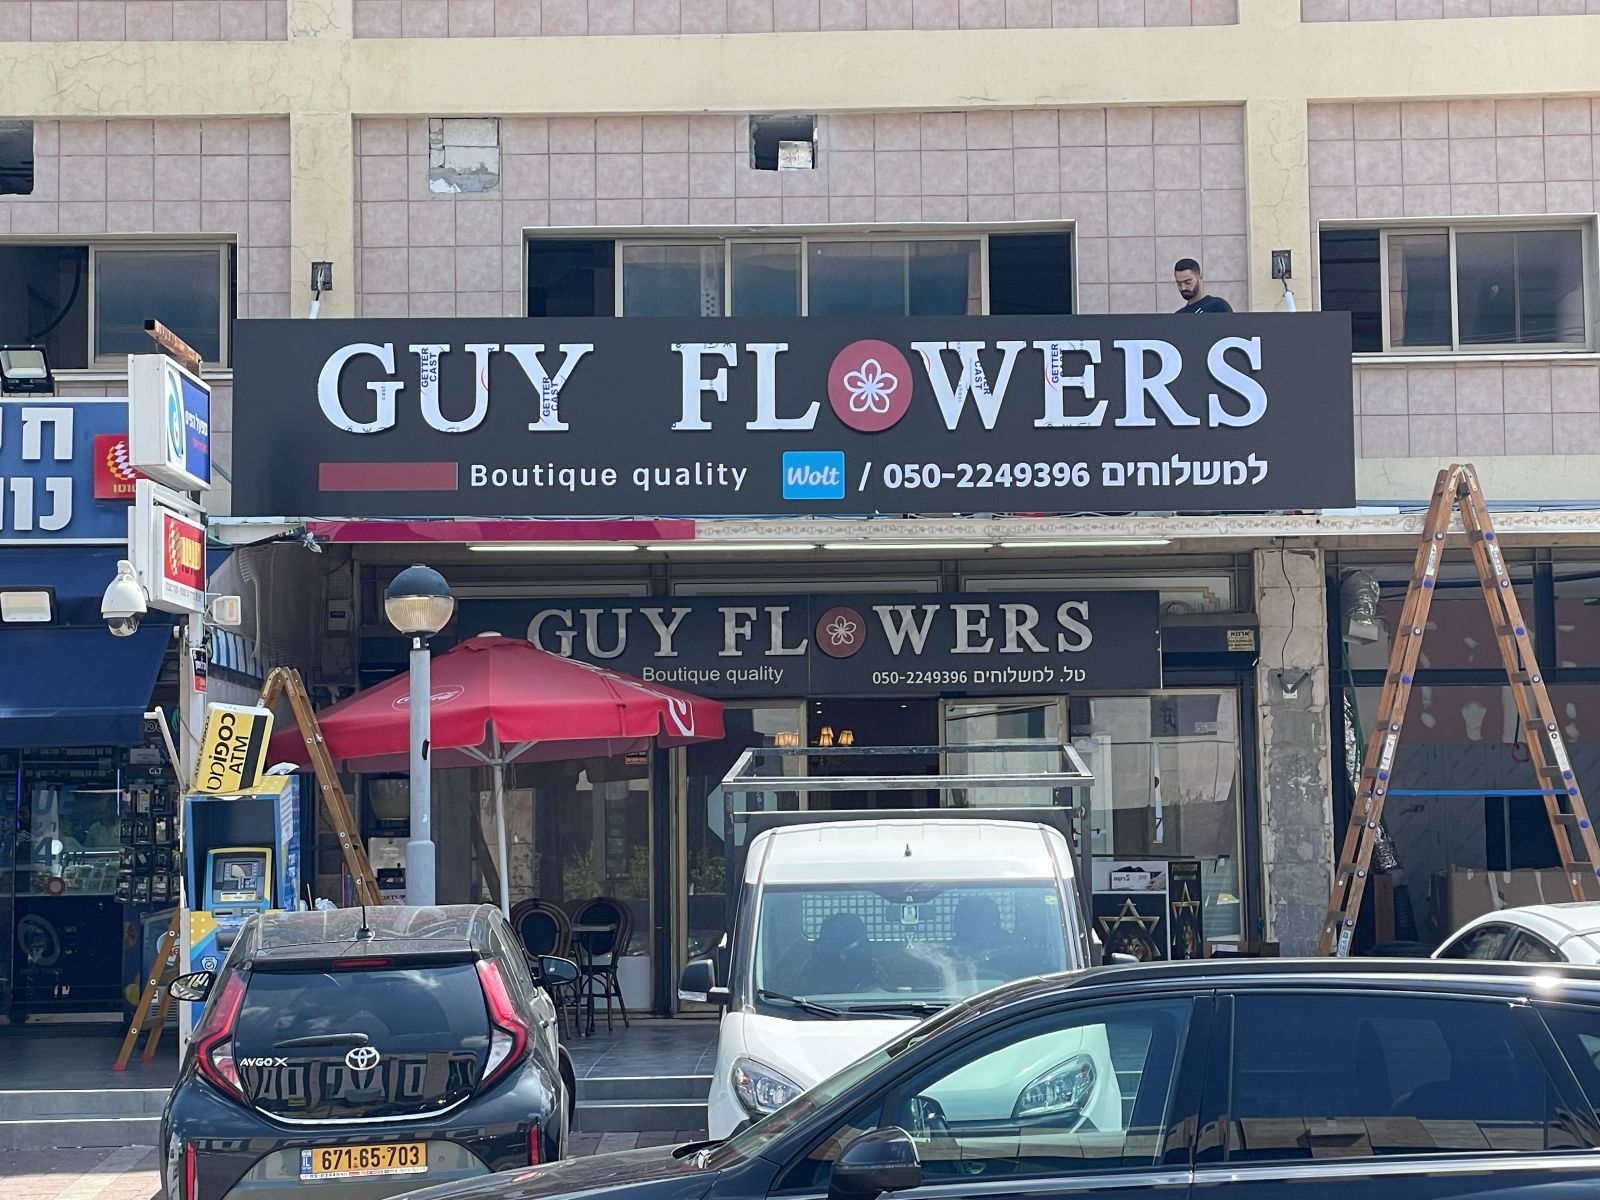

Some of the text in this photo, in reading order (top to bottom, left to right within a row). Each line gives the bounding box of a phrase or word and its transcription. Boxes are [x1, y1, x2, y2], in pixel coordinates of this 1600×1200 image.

[317, 342, 594, 433] GUY
[472, 463, 748, 491] Boutique quality
[787, 466, 840, 486] Wolt
[883, 462, 1090, 488] 050-2249396
[1102, 453, 1268, 487] למשלוחים
[527, 607, 692, 659] GUY
[642, 666, 784, 685] Boutique quality
[872, 666, 1086, 684] טל. למשלוחים 050-2249396
[228, 736, 249, 775] ATM
